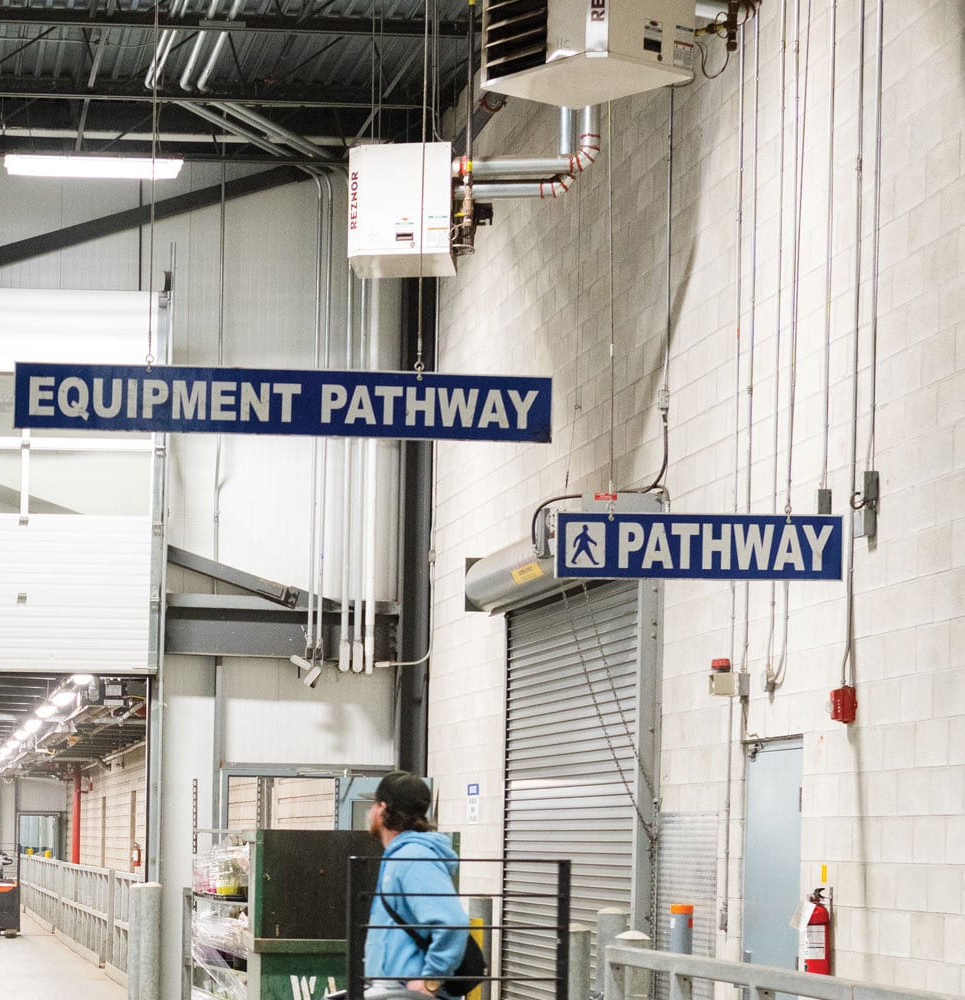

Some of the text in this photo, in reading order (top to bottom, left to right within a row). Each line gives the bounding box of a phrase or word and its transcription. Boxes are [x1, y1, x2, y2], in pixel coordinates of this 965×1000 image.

[350, 171, 359, 230] REZNOR
[28, 375, 539, 430] EQUIPMENT PATHWAY
[618, 522, 834, 571] PATHWAY
